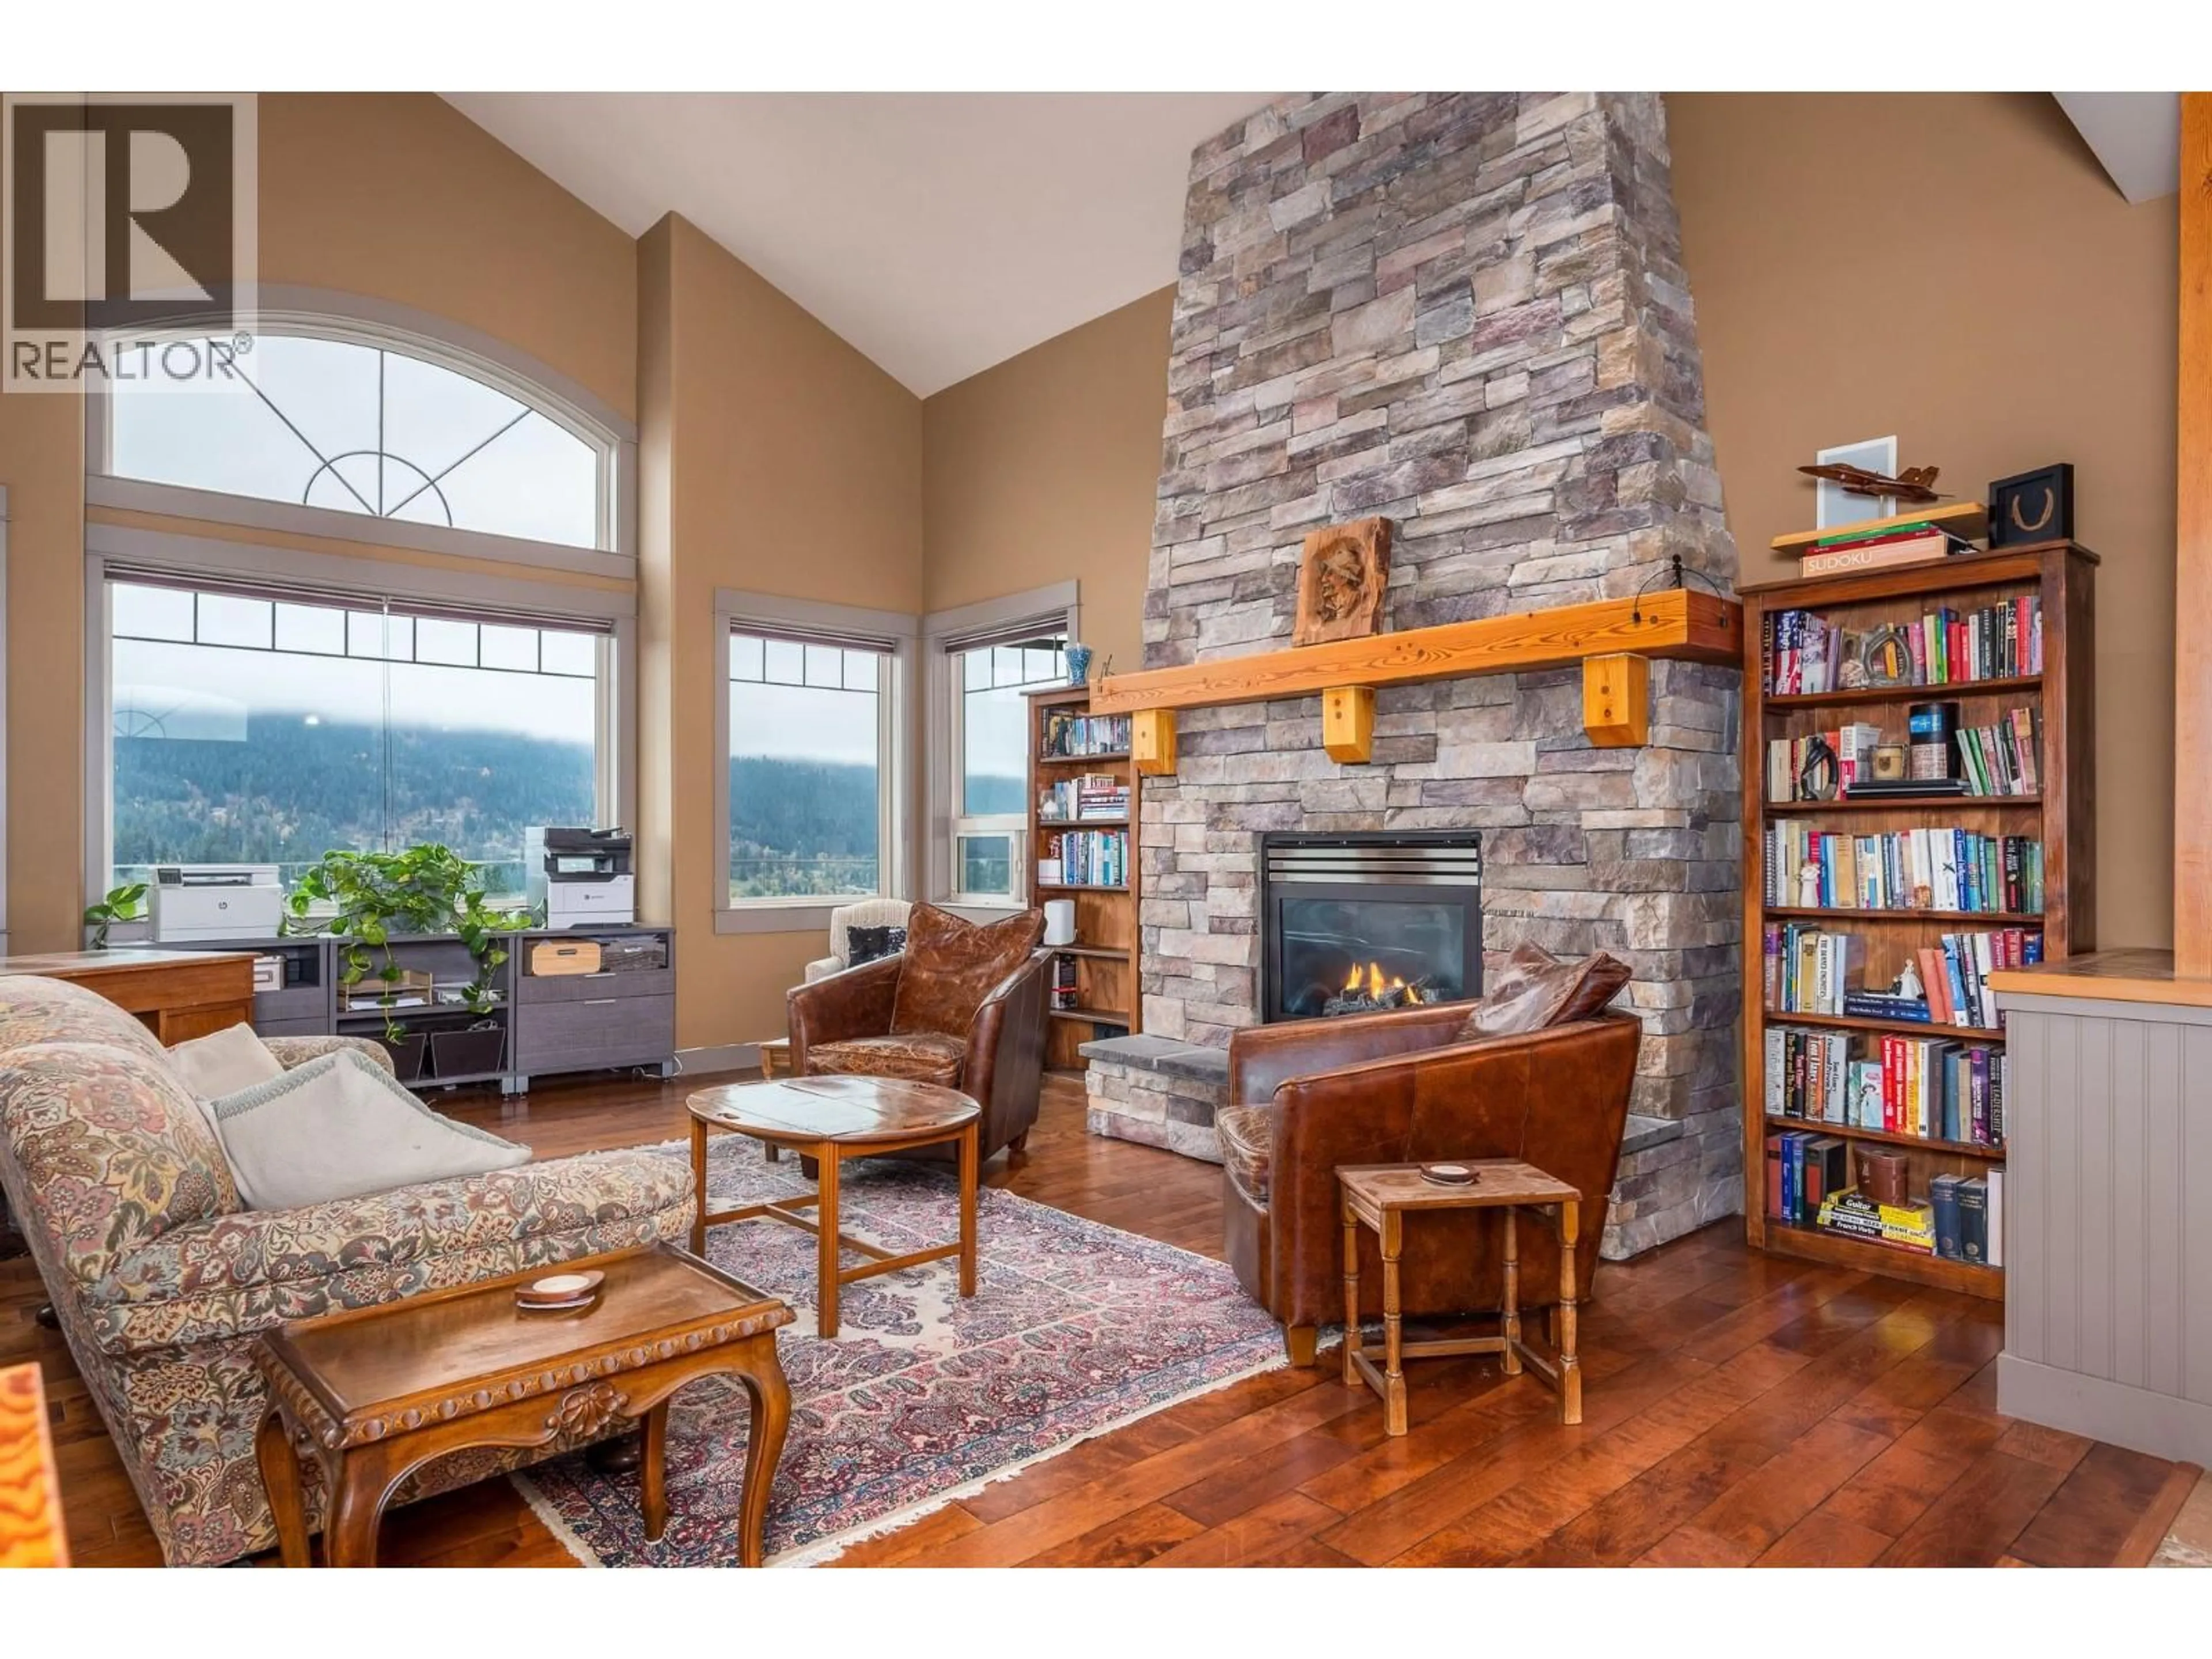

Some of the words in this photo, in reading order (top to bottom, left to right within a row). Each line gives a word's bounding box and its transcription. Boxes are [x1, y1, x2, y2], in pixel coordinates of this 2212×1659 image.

[1808, 551, 1872, 571] SUDOKU
[1810, 1039, 1821, 1055] Tom
[1993, 1084, 2002, 1132] LEADERSHIP
[1846, 1199, 1871, 1210] Guitar
